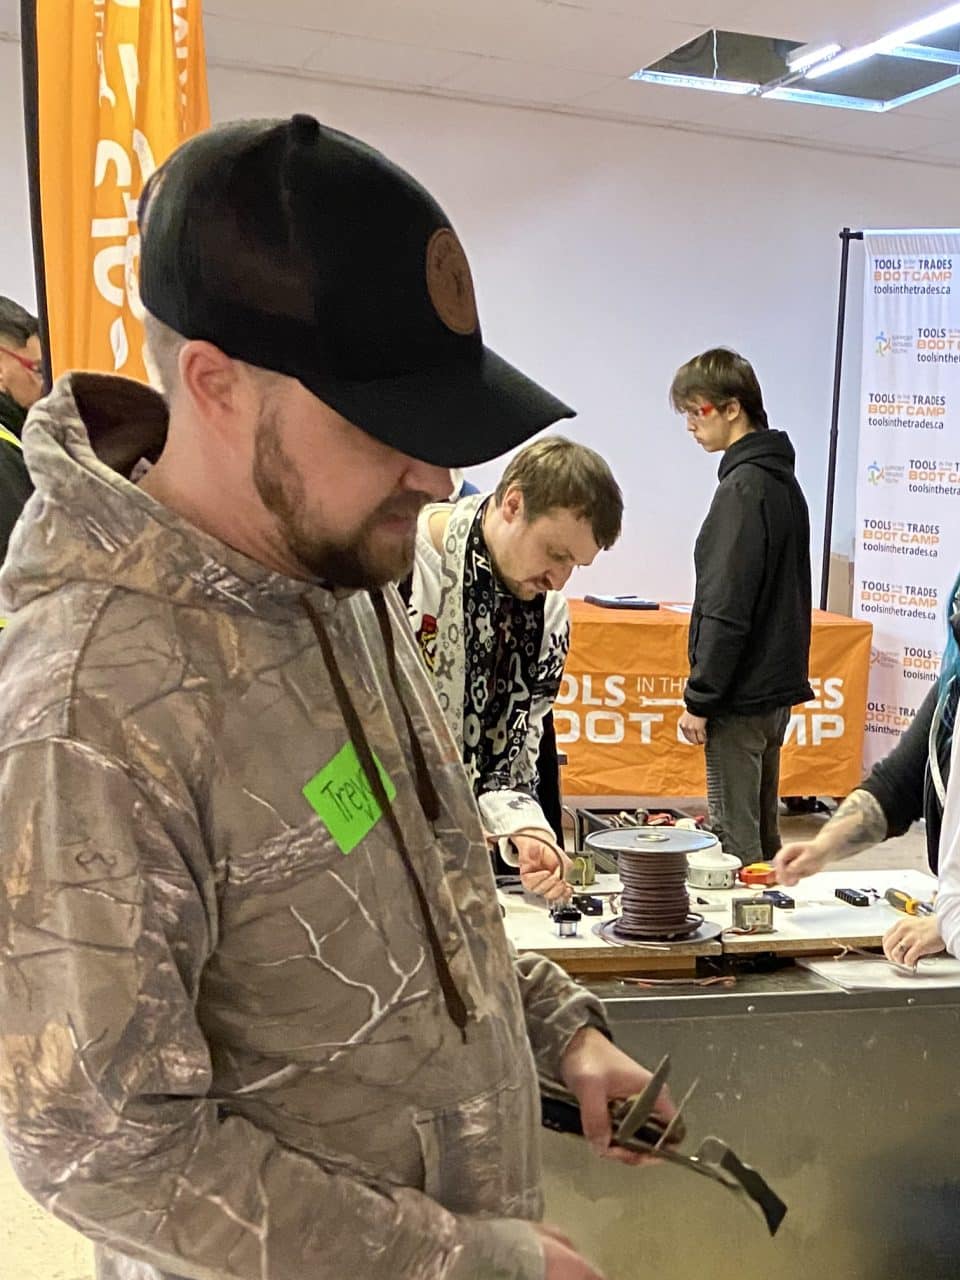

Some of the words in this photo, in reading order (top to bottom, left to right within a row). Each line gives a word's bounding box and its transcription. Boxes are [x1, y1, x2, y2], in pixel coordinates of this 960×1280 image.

[875, 259, 901, 269] TOOLS
[919, 259, 952, 269] TRADES
[874, 271, 911, 281] BOOT
[912, 271, 952, 281] CAMP
[874, 284, 950, 294] toolsinthetrades.ca
[918, 328, 945, 338] TOOLS
[917, 340, 954, 350] BOOT
[869, 393, 895, 403] TOOLS
[913, 395, 945, 405] TRADES
[868, 404, 904, 414] BOOT
[906, 406, 945, 416] CAMP
[869, 418, 943, 429] toolsinthetrades.ca
[910, 460, 936, 470] TOOLS
[909, 470, 945, 481] BOOT
[864, 520, 891, 530] TOOLS
[907, 523, 939, 534] TRADES
[863, 530, 898, 540] BOOT
[900, 533, 939, 545] CAMP
[864, 543, 937, 557] toolsinthetrades.ca
[863, 581, 889, 592] TOOLS
[906, 586, 937, 597] TRADES
[861, 592, 897, 602] BOOT
[898, 596, 937, 608] CAMP
[861, 604, 935, 620] toolsinthetrades.ca
[904, 647, 931, 658] TOOLS
[903, 658, 939, 669] BOOT
[556, 674, 626, 707] OLS
[637, 677, 654, 692] IN
[867, 703, 885, 712] OLS
[552, 710, 664, 744] OOT
